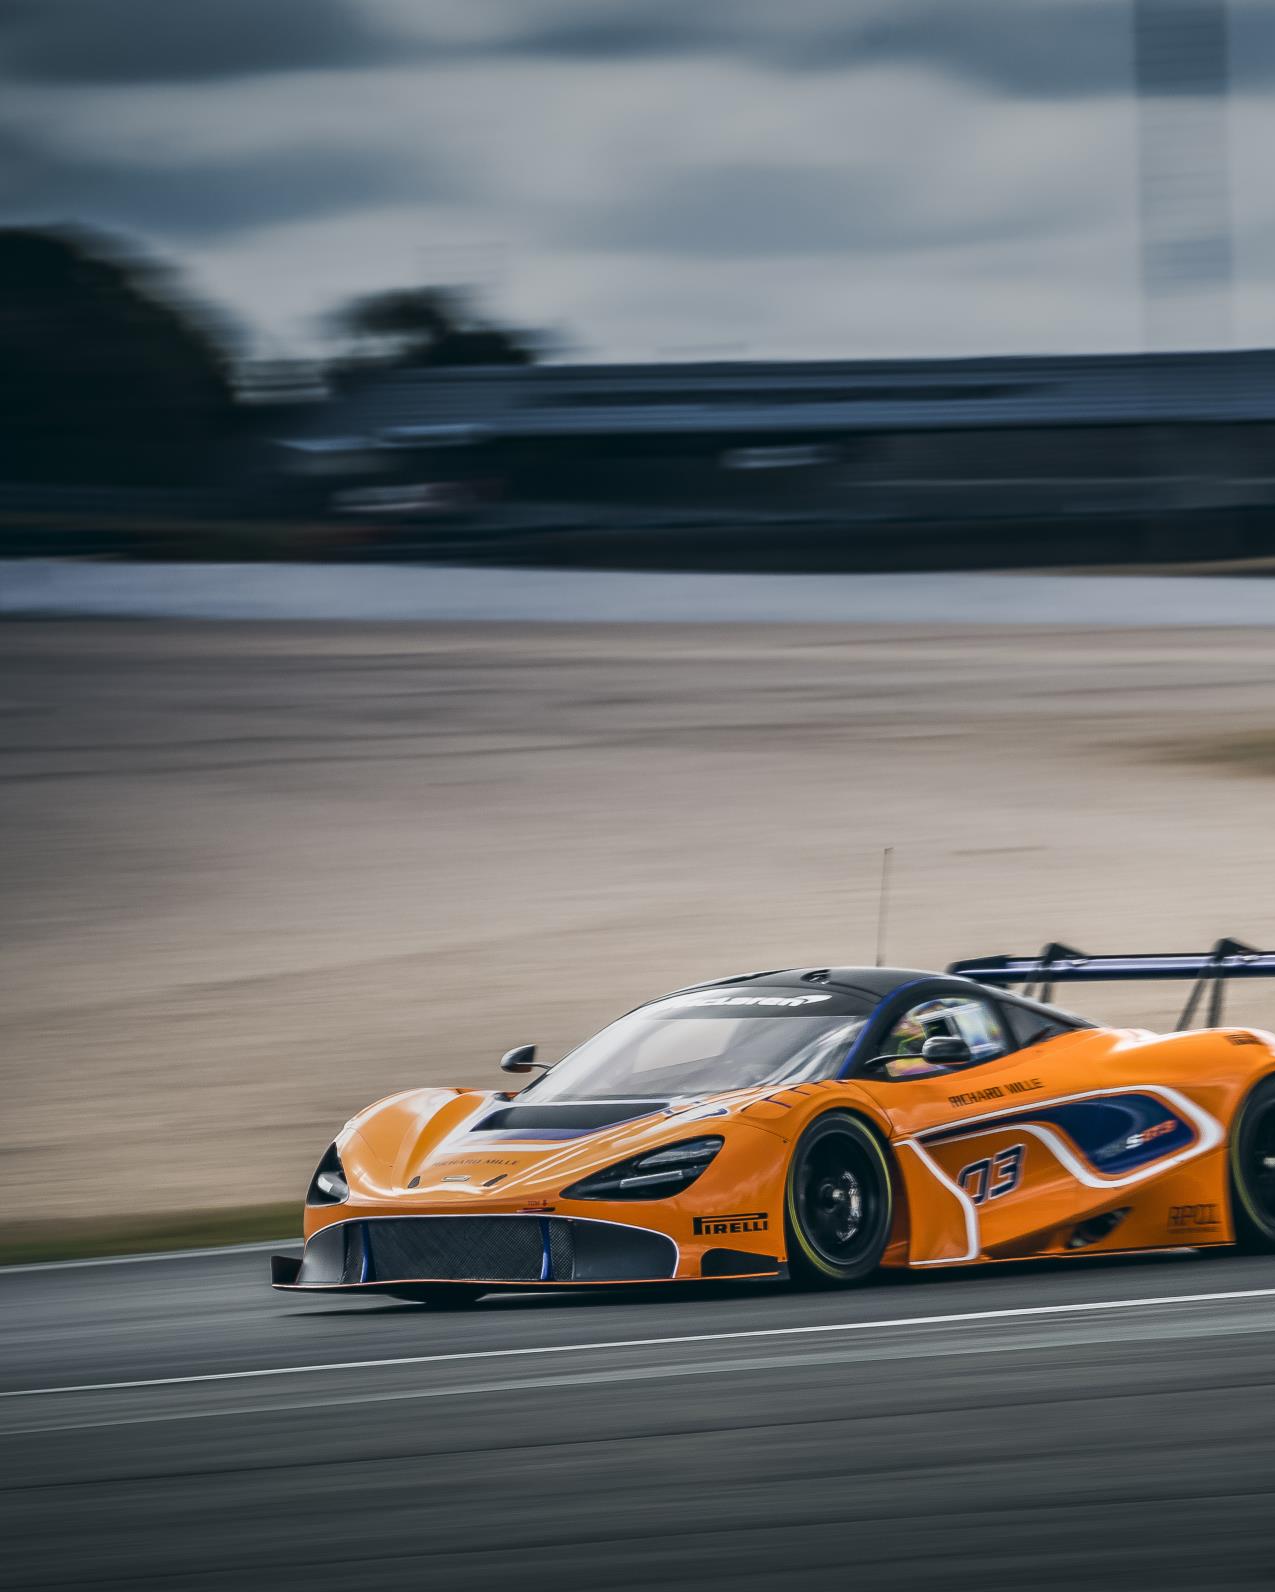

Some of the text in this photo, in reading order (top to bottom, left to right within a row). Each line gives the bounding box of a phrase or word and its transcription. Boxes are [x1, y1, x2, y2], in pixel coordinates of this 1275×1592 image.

[947, 1077, 1046, 1108] RICHARD MILLE
[956, 1144, 1028, 1207] 03
[693, 1212, 768, 1235] PIRELLI
